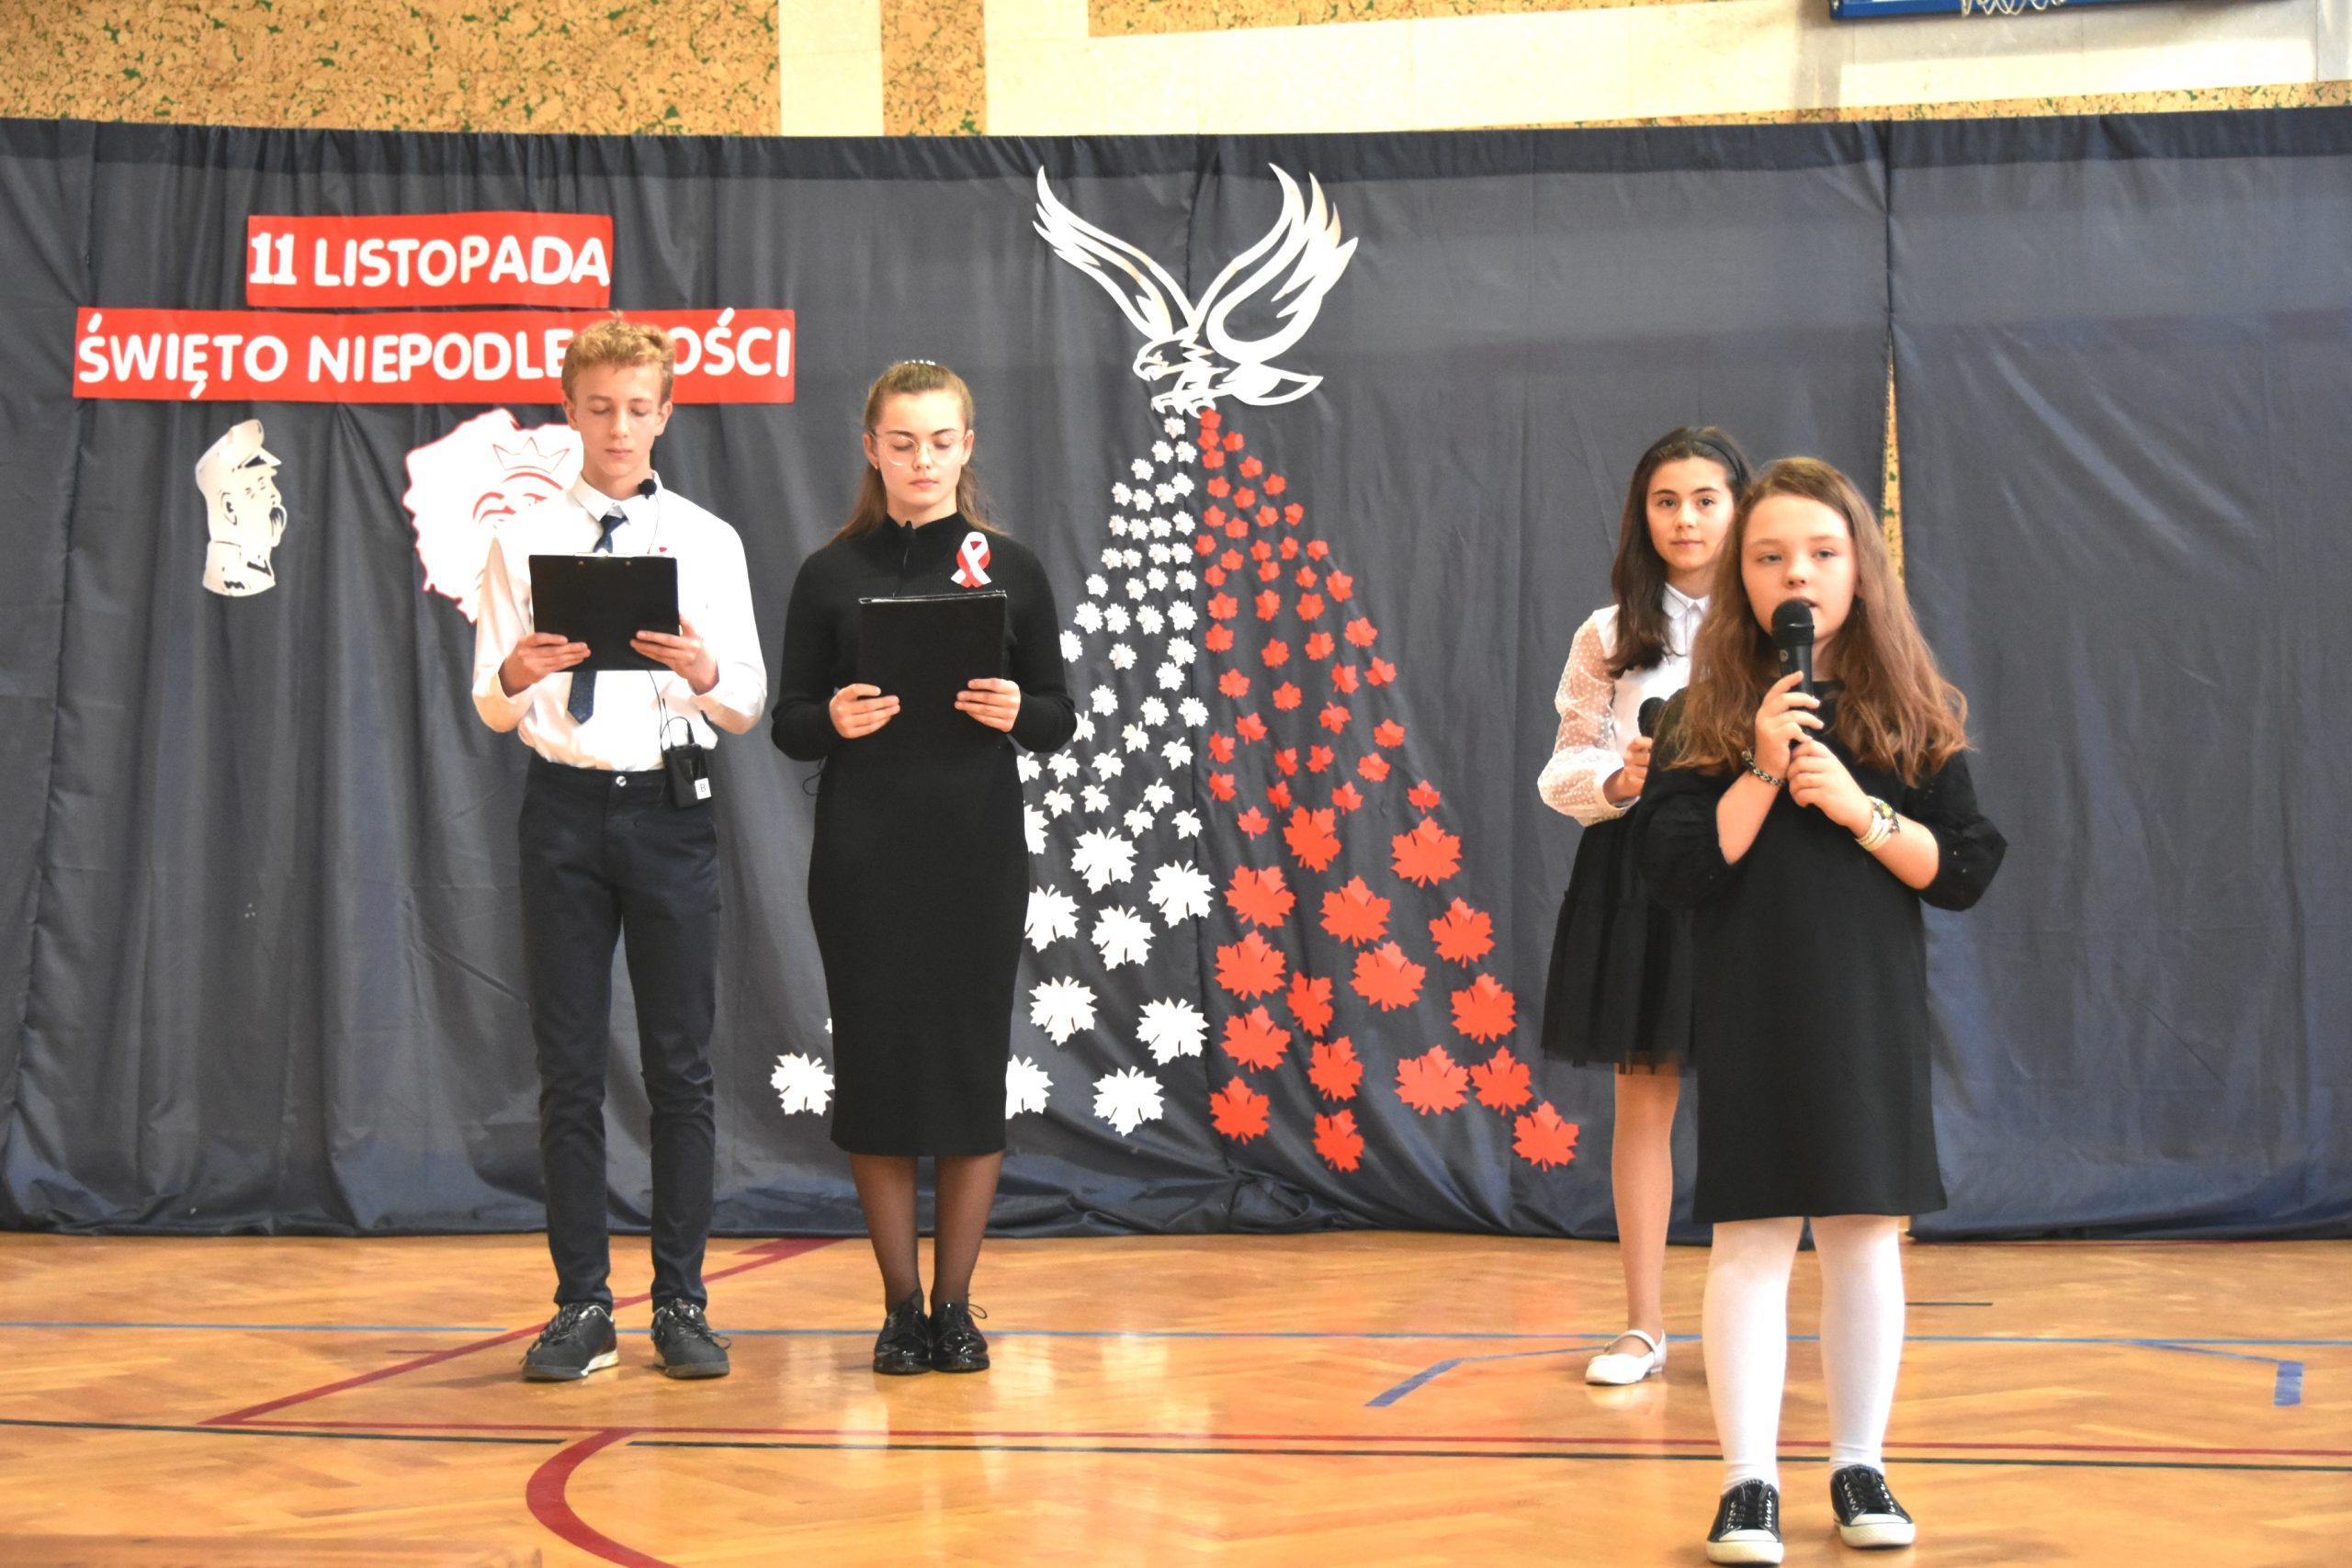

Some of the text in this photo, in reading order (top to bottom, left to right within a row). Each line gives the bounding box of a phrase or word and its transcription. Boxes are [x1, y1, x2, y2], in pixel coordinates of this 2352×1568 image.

[249, 231, 611, 288] 11 LISTOPADA
[77, 307, 791, 400] ŚWIĘTO NIEPODLEOŚCI
